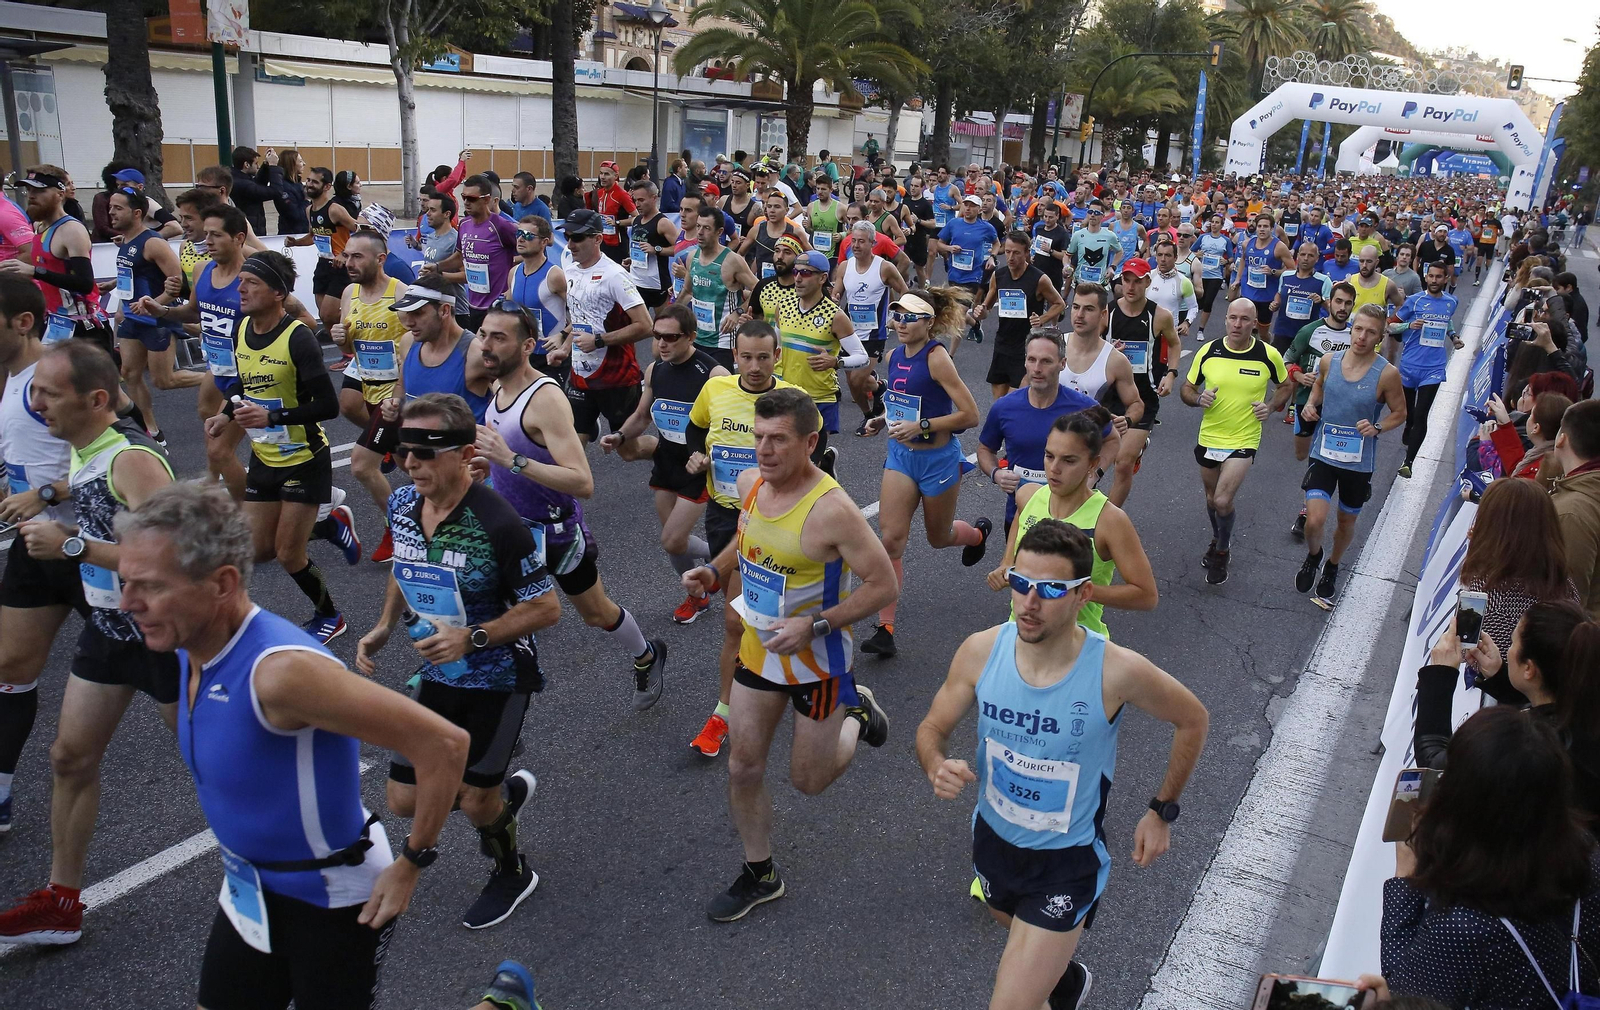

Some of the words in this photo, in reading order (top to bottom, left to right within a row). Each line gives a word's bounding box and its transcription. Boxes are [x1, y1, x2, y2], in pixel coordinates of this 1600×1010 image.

[1259, 101, 1284, 123] PayPal
[1329, 98, 1382, 114] PayPal
[1423, 106, 1479, 122] PayPal
[1510, 132, 1534, 157] PayPal
[466, 242, 474, 250] 24
[466, 252, 490, 260] MARATON
[1248, 256, 1267, 266] RCM
[199, 300, 236, 316] HERBALIFE
[200, 311, 234, 337] 24
[260, 355, 287, 366] Fontana
[895, 396, 909, 404] ZURICH
[668, 418, 680, 426] 109
[895, 410, 904, 419] 253
[374, 428, 384, 444] Joma
[730, 452, 753, 460] ZURICH
[761, 554, 797, 576] Álora
[414, 571, 440, 581] ZURICH
[747, 569, 770, 584] ZURICH
[416, 593, 435, 605] 389
[746, 588, 759, 603] 182
[983, 701, 1060, 735] nerja
[990, 727, 1046, 748] ATLETISMO
[1017, 758, 1055, 773] ZURICH
[1008, 782, 1040, 801] 3526
